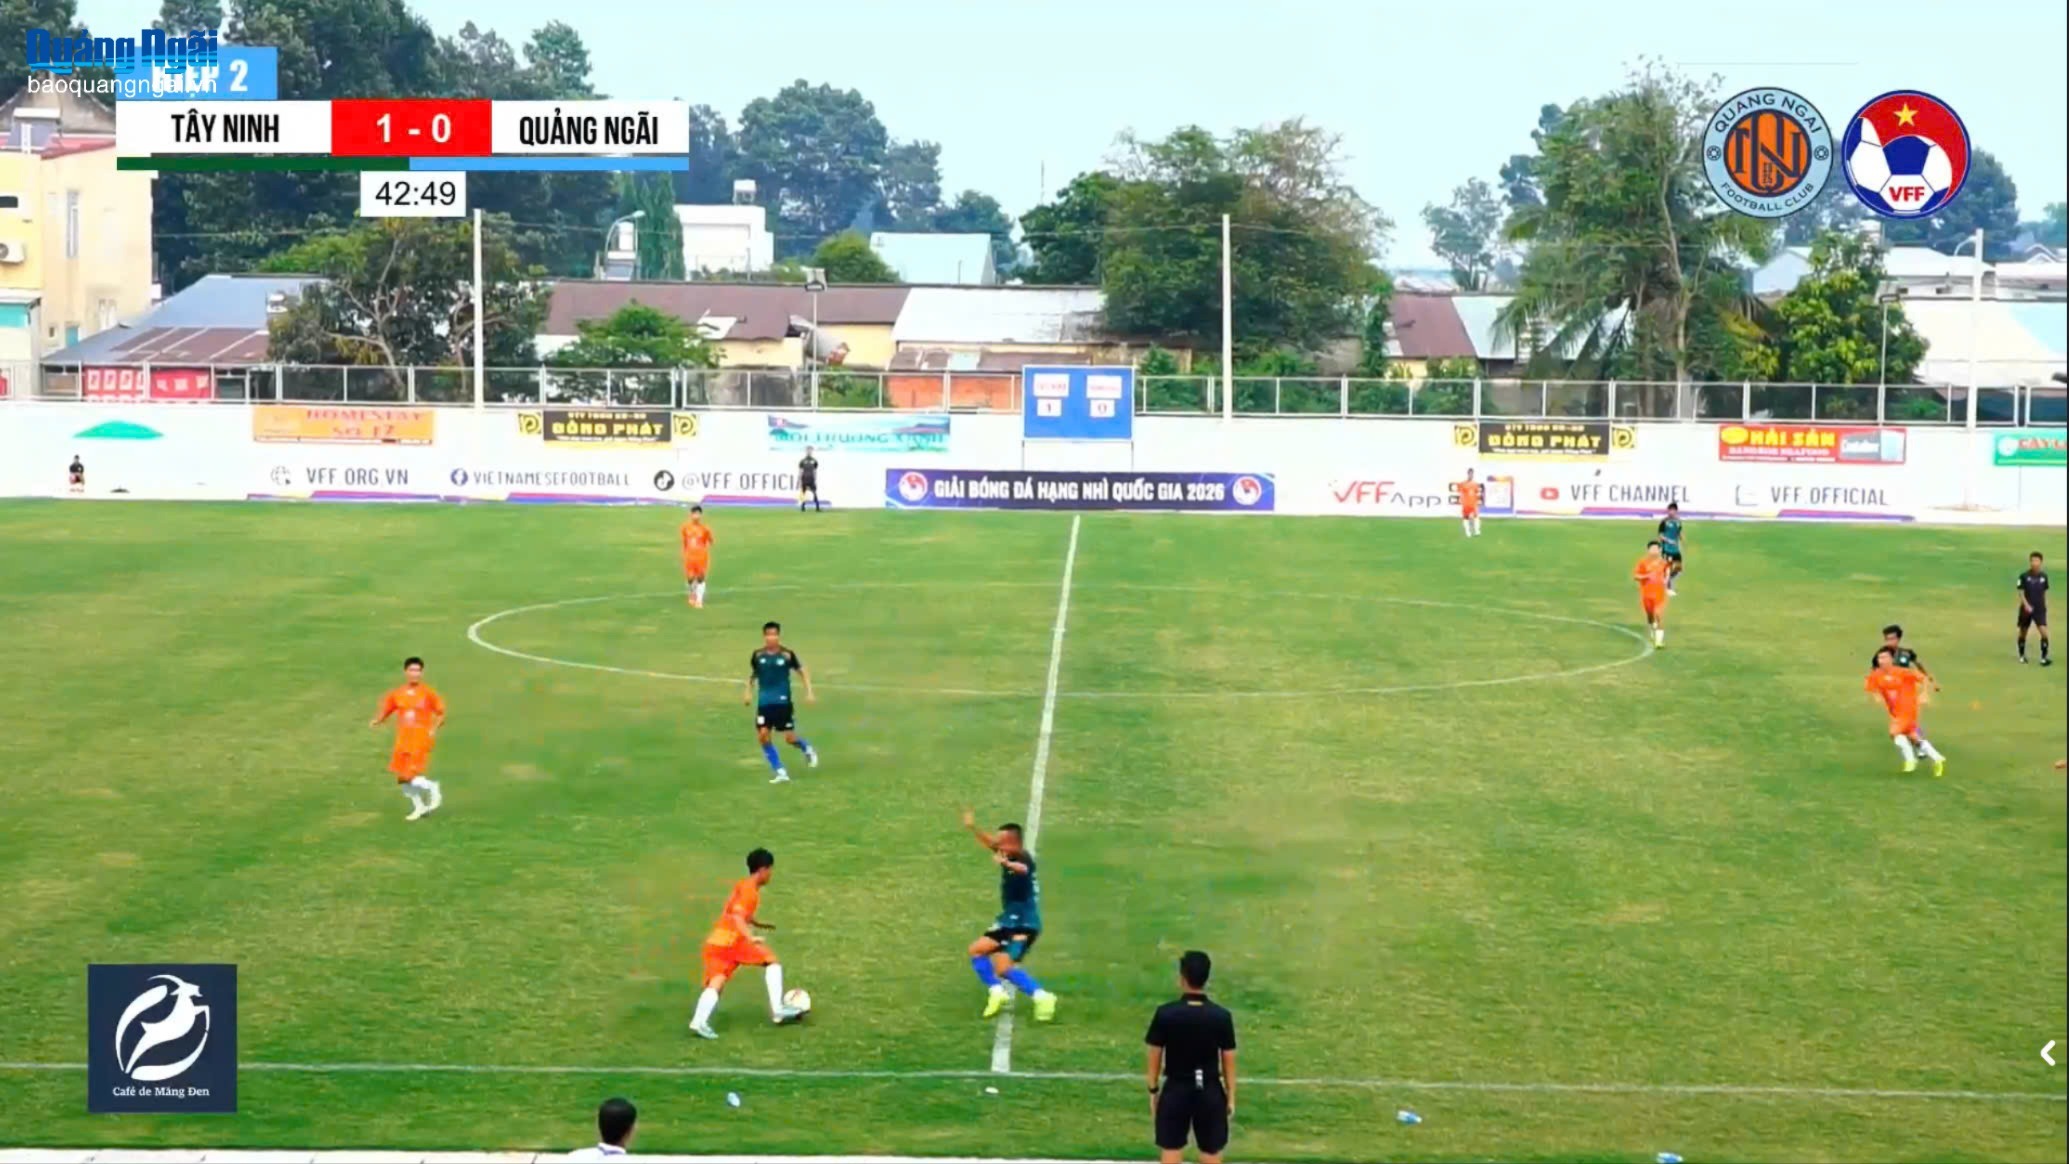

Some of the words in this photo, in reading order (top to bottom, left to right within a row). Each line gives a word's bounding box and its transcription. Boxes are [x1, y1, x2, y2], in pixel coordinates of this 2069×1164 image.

[472, 471, 630, 487] VIETNAMESEFOOTBALL
[934, 474, 965, 498] GIẢI
[968, 475, 1010, 498] BÓNG
[1013, 476, 1034, 499] ĐÁ
[1037, 481, 1079, 504] HẠNG
[1082, 477, 1109, 501] NHÌ
[1112, 476, 1155, 503] QUỐC
[1158, 482, 1184, 501] GIA
[1186, 482, 1225, 501] 2026
[1333, 480, 1395, 504] VFF
[1570, 484, 1603, 502] VFF
[1608, 484, 1691, 504] CHANNEL
